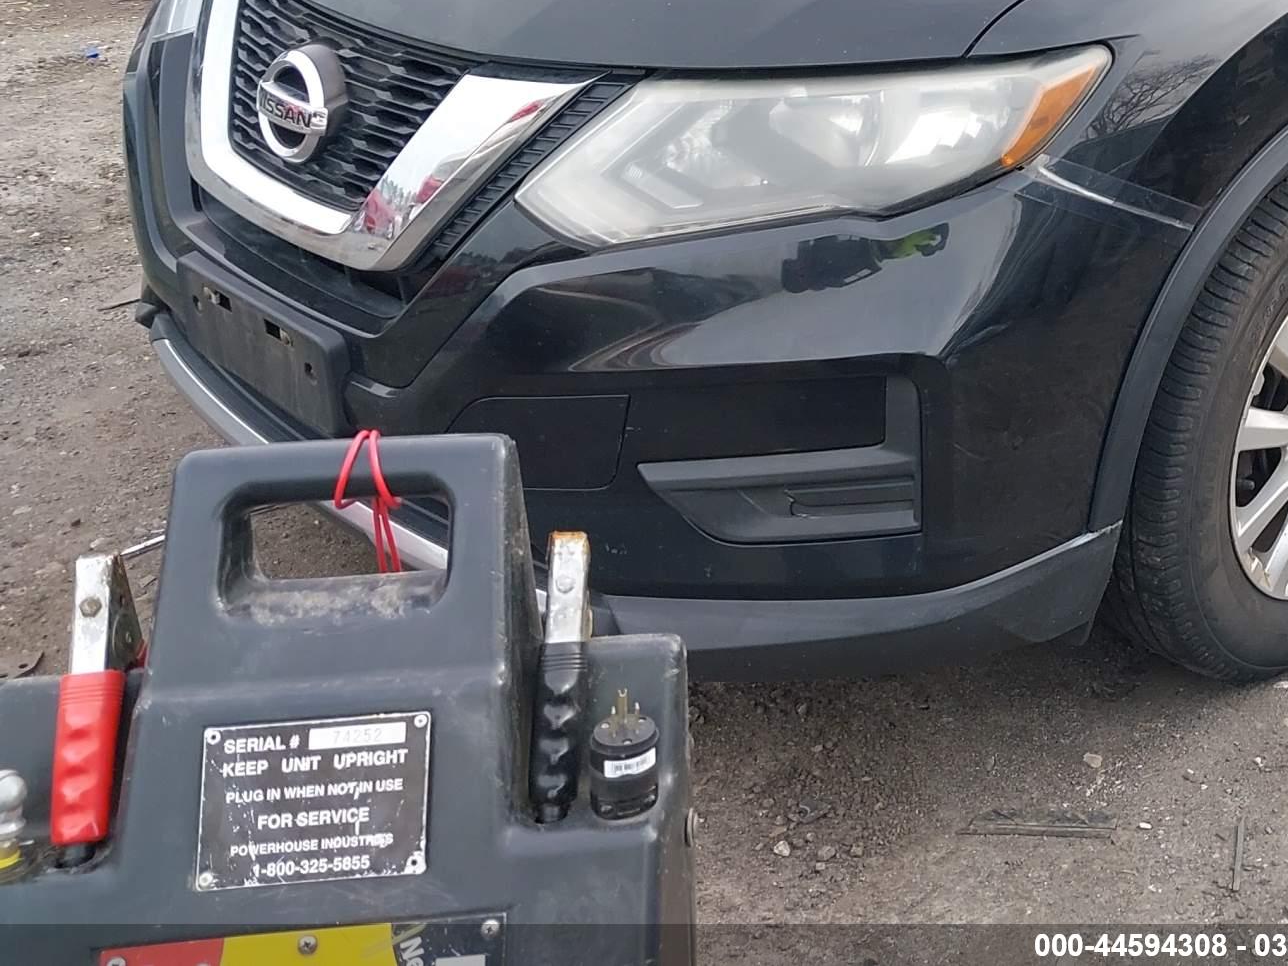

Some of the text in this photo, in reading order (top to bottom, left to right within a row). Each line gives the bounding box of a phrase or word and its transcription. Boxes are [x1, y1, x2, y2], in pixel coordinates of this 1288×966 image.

[260, 87, 312, 128] NISSAN
[223, 728, 383, 754] SERIAL # 74252
[222, 749, 408, 778] KEEP UNIT UPRIGHT
[226, 778, 403, 804] PLUG IN WHEN NOT IN USE
[257, 807, 370, 829] FOR SERVICE
[230, 840, 317, 857] POWERHOUSE
[253, 855, 370, 877] 1-800-325-5855
